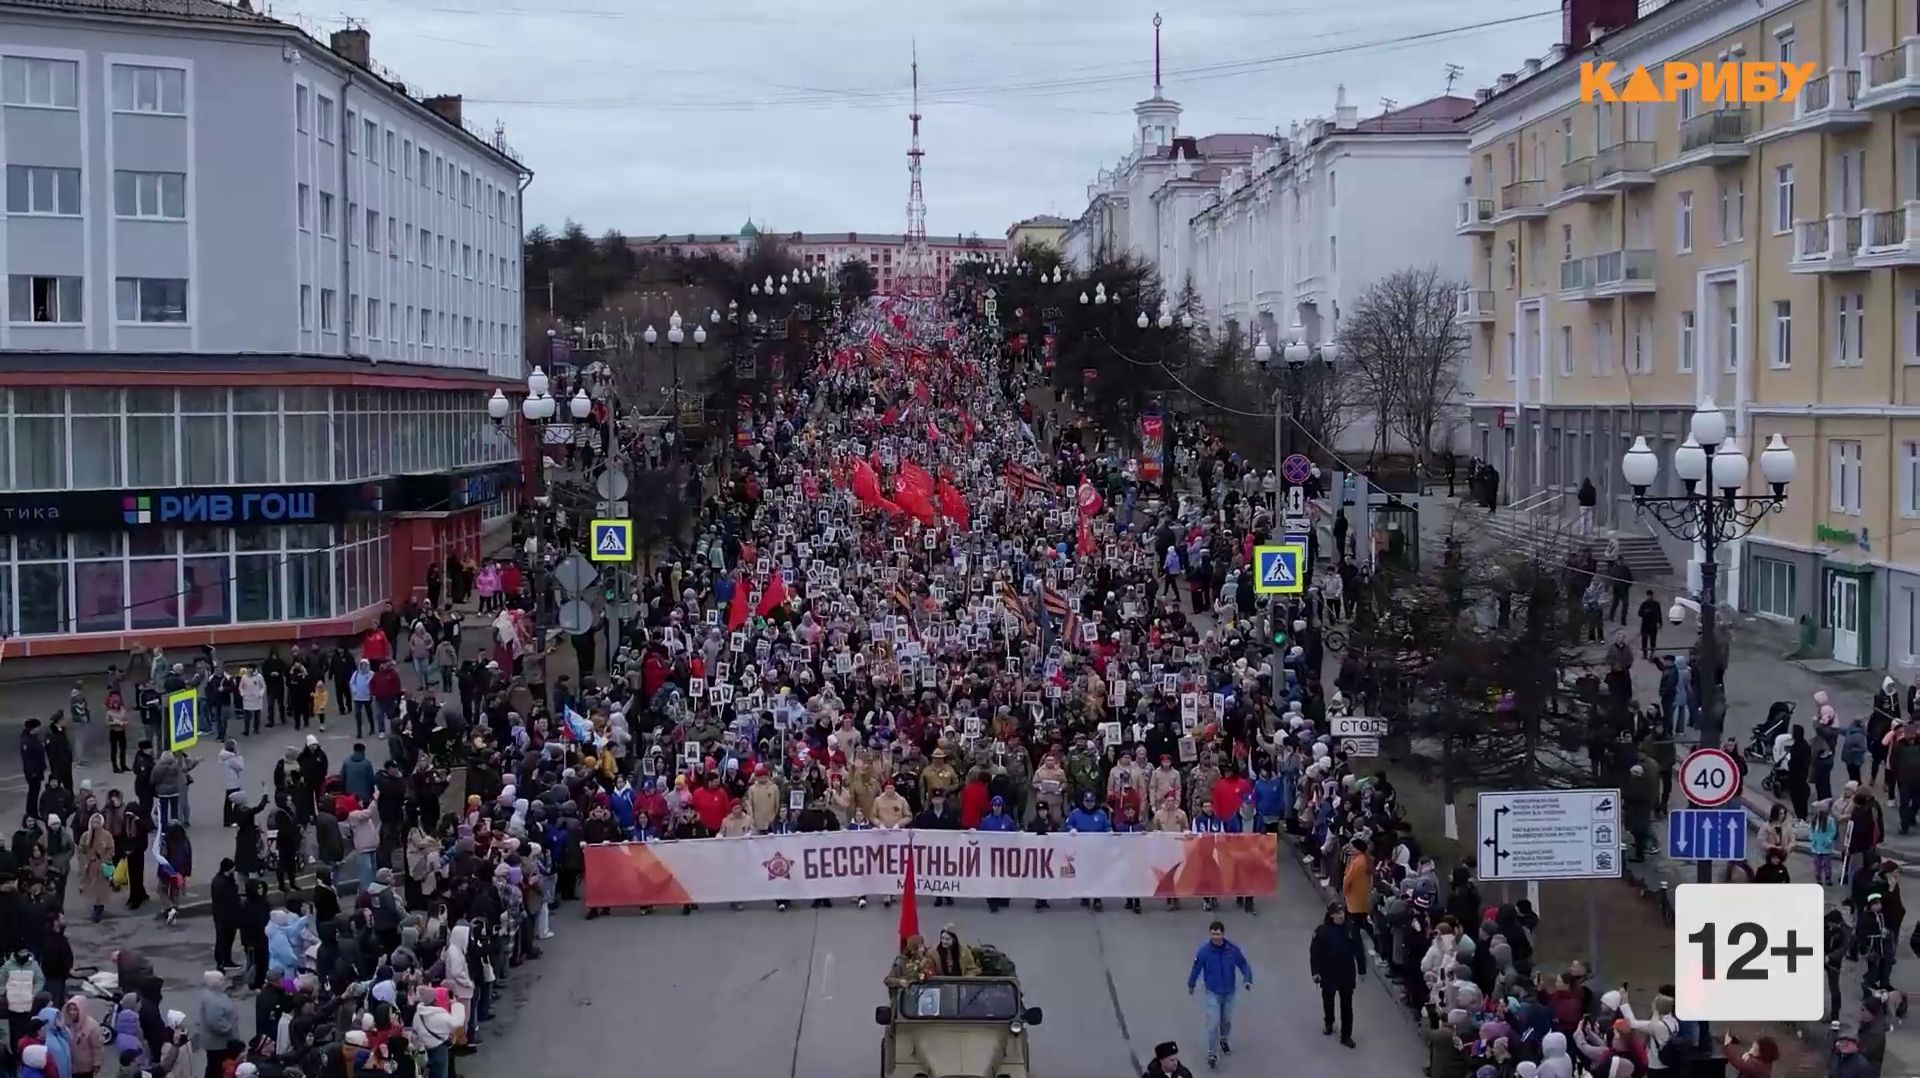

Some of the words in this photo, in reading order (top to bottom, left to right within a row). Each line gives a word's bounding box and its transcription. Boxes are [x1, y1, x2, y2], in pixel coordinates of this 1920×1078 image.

[160, 495, 233, 522] РИВ
[242, 493, 315, 520] ГОШ
[1694, 768, 1726, 789] 40
[803, 840, 981, 880] БЕССМЕРТНЫЙ
[990, 847, 1055, 879] ПОЛК
[897, 879, 960, 892] МГАДАН
